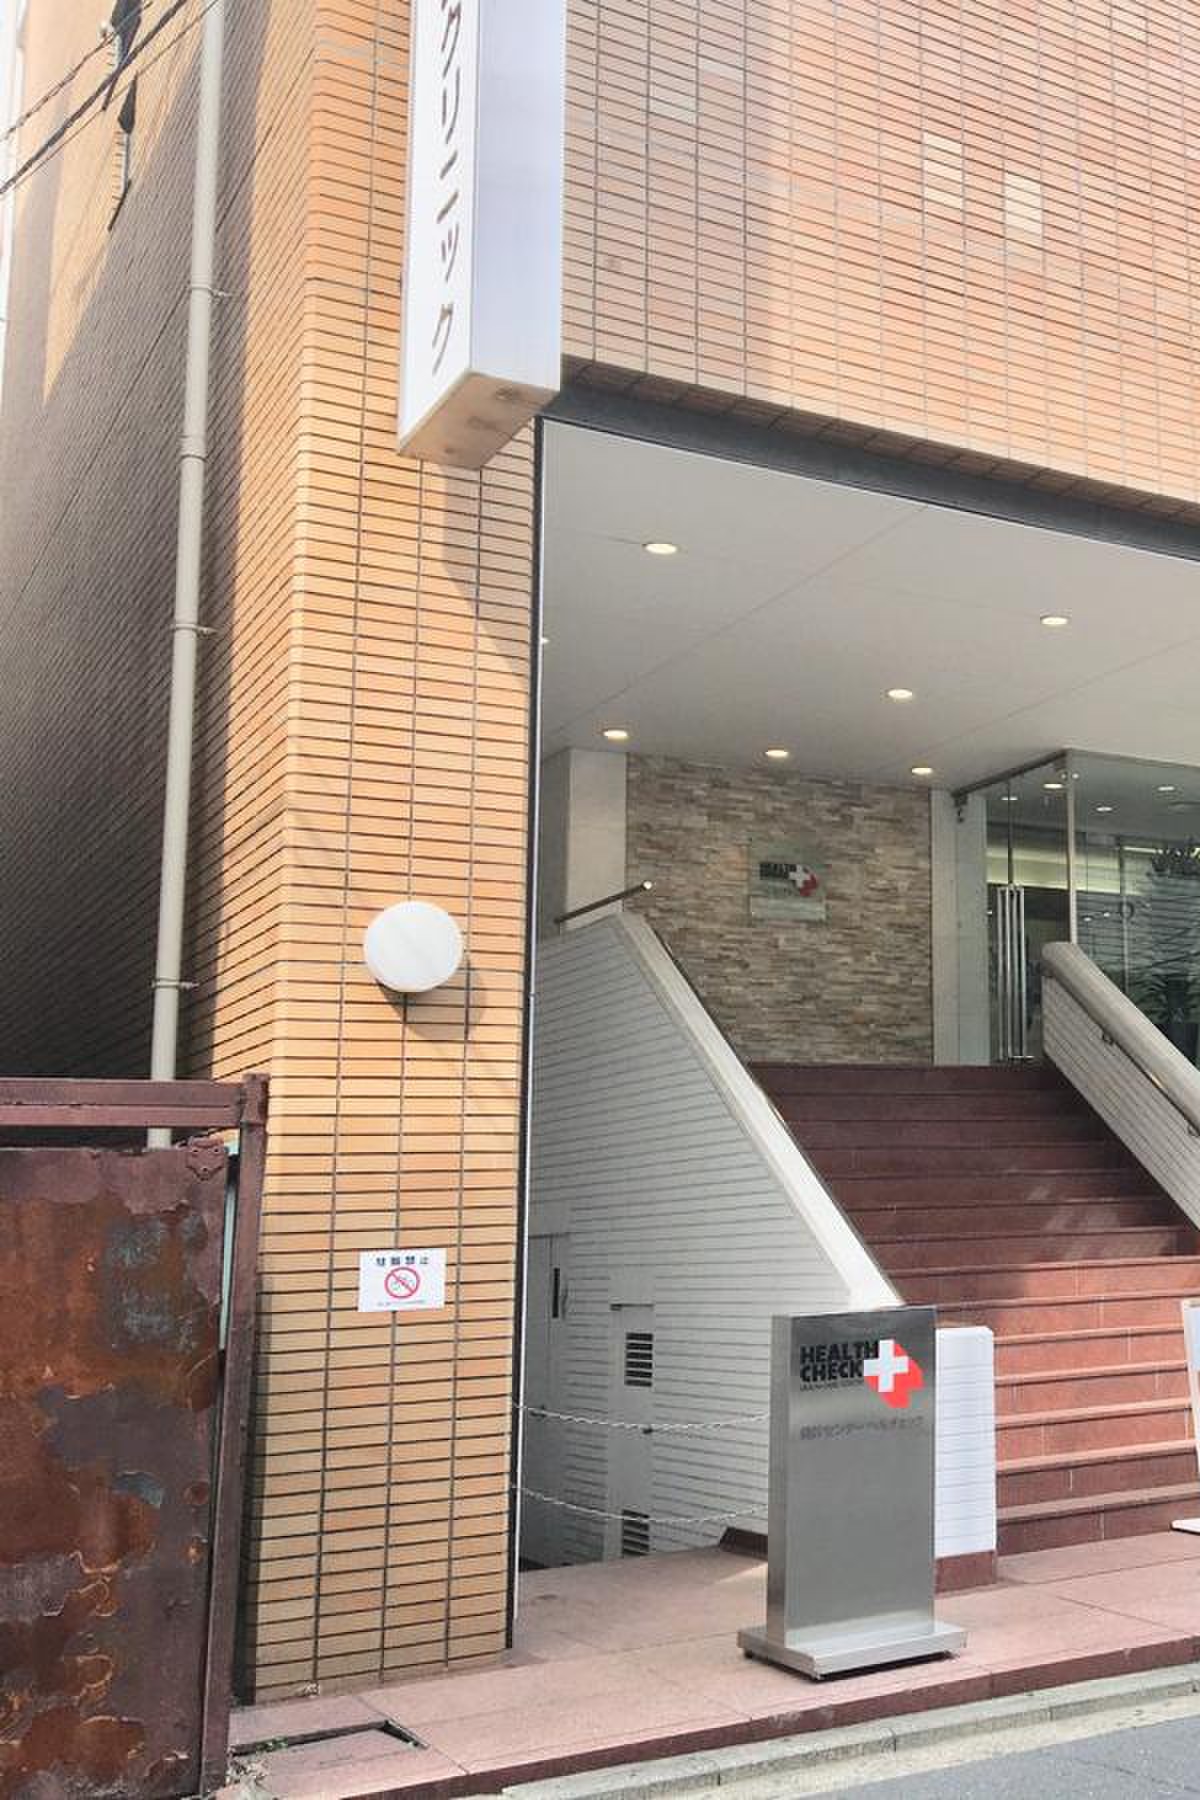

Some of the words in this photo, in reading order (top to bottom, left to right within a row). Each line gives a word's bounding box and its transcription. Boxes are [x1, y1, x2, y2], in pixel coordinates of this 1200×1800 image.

[431, 0, 462, 375] クリニック
[801, 1341, 879, 1364] HEALTH
[801, 1360, 865, 1383] CHECK
